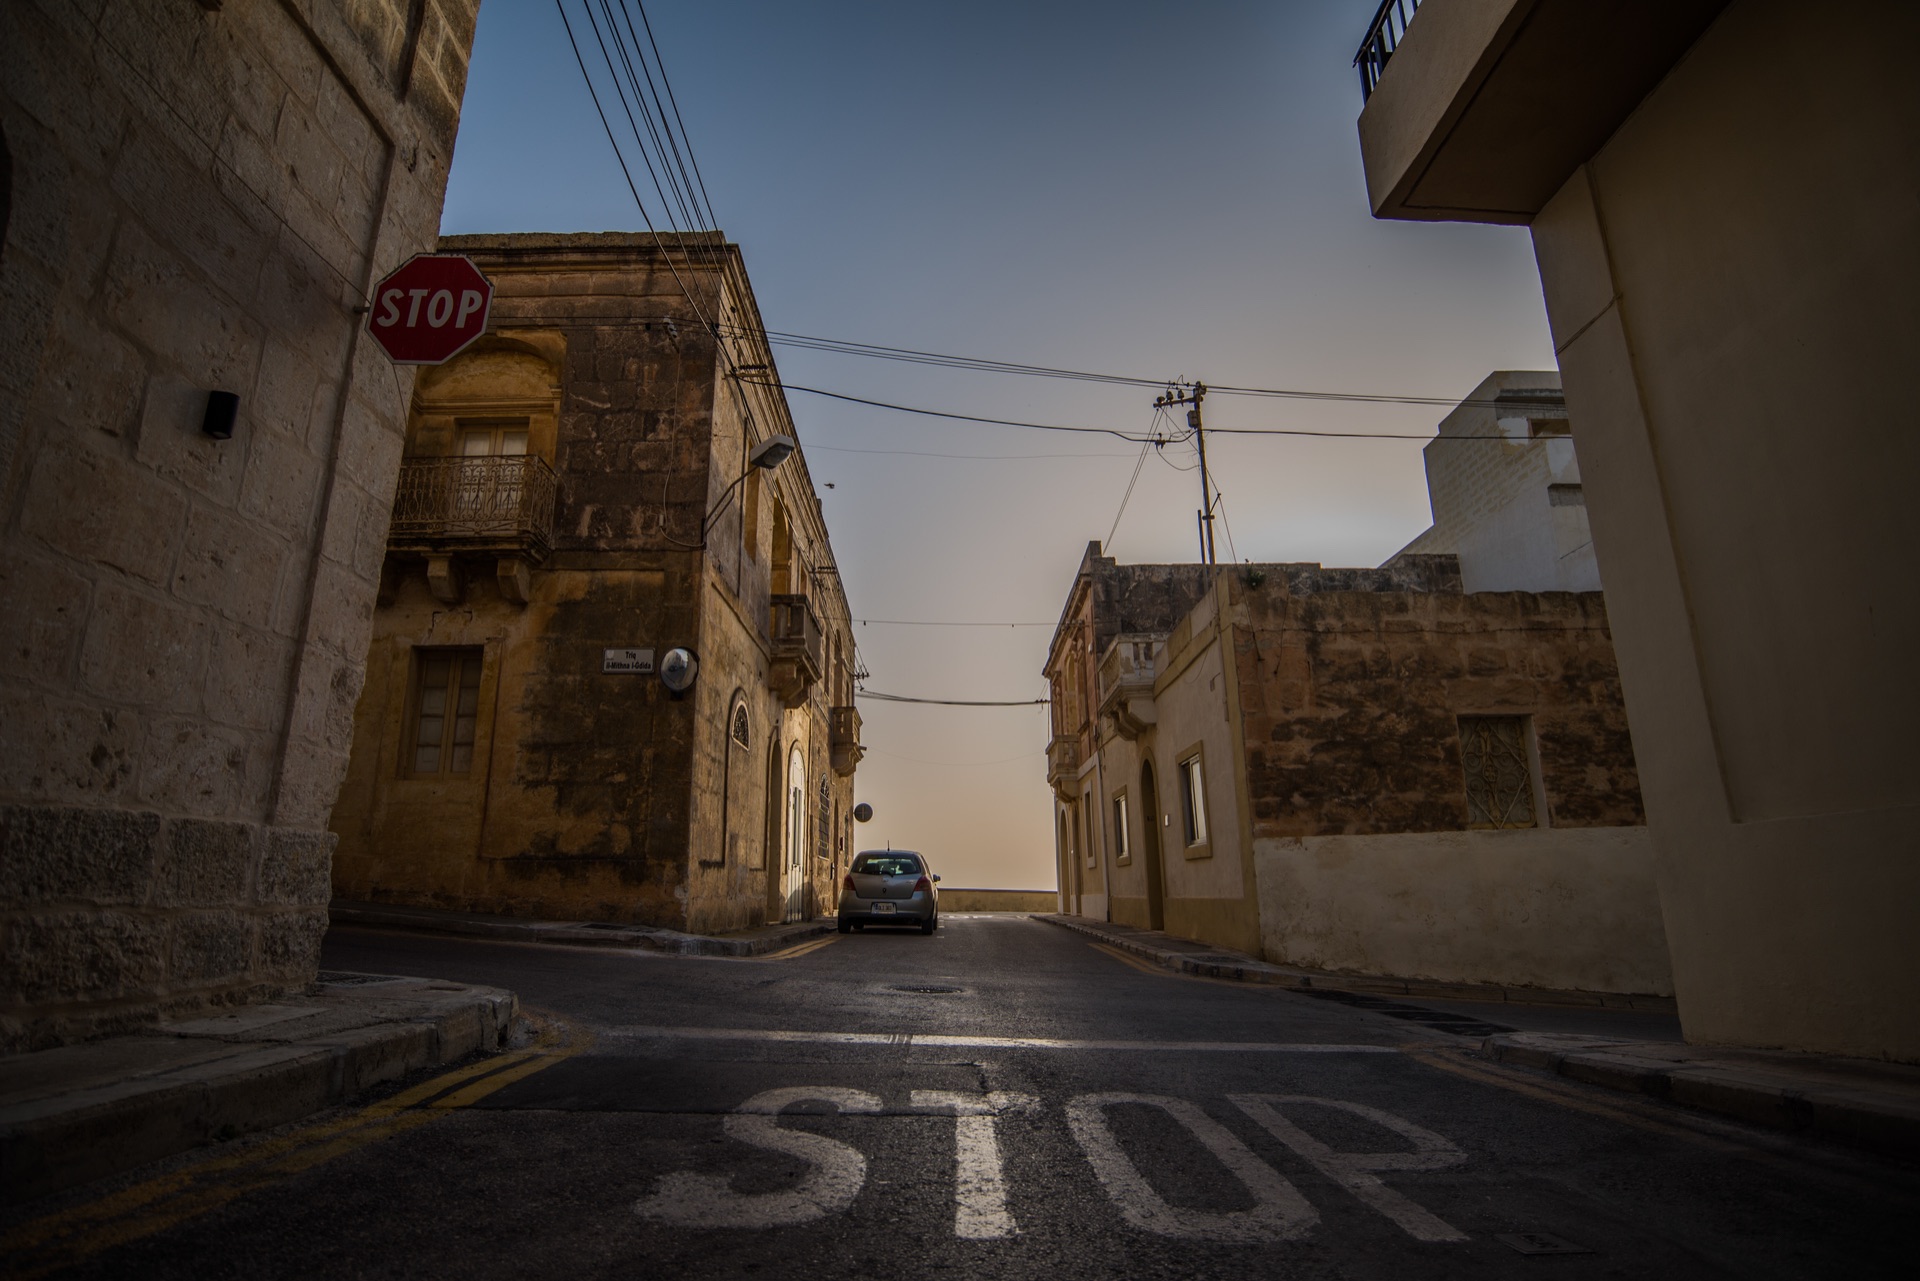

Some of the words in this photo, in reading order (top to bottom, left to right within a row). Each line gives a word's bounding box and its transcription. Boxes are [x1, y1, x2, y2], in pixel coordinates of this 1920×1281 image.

[376, 288, 483, 329] STOP
[625, 651, 636, 660] Triq
[633, 1084, 1471, 1242] STOP
